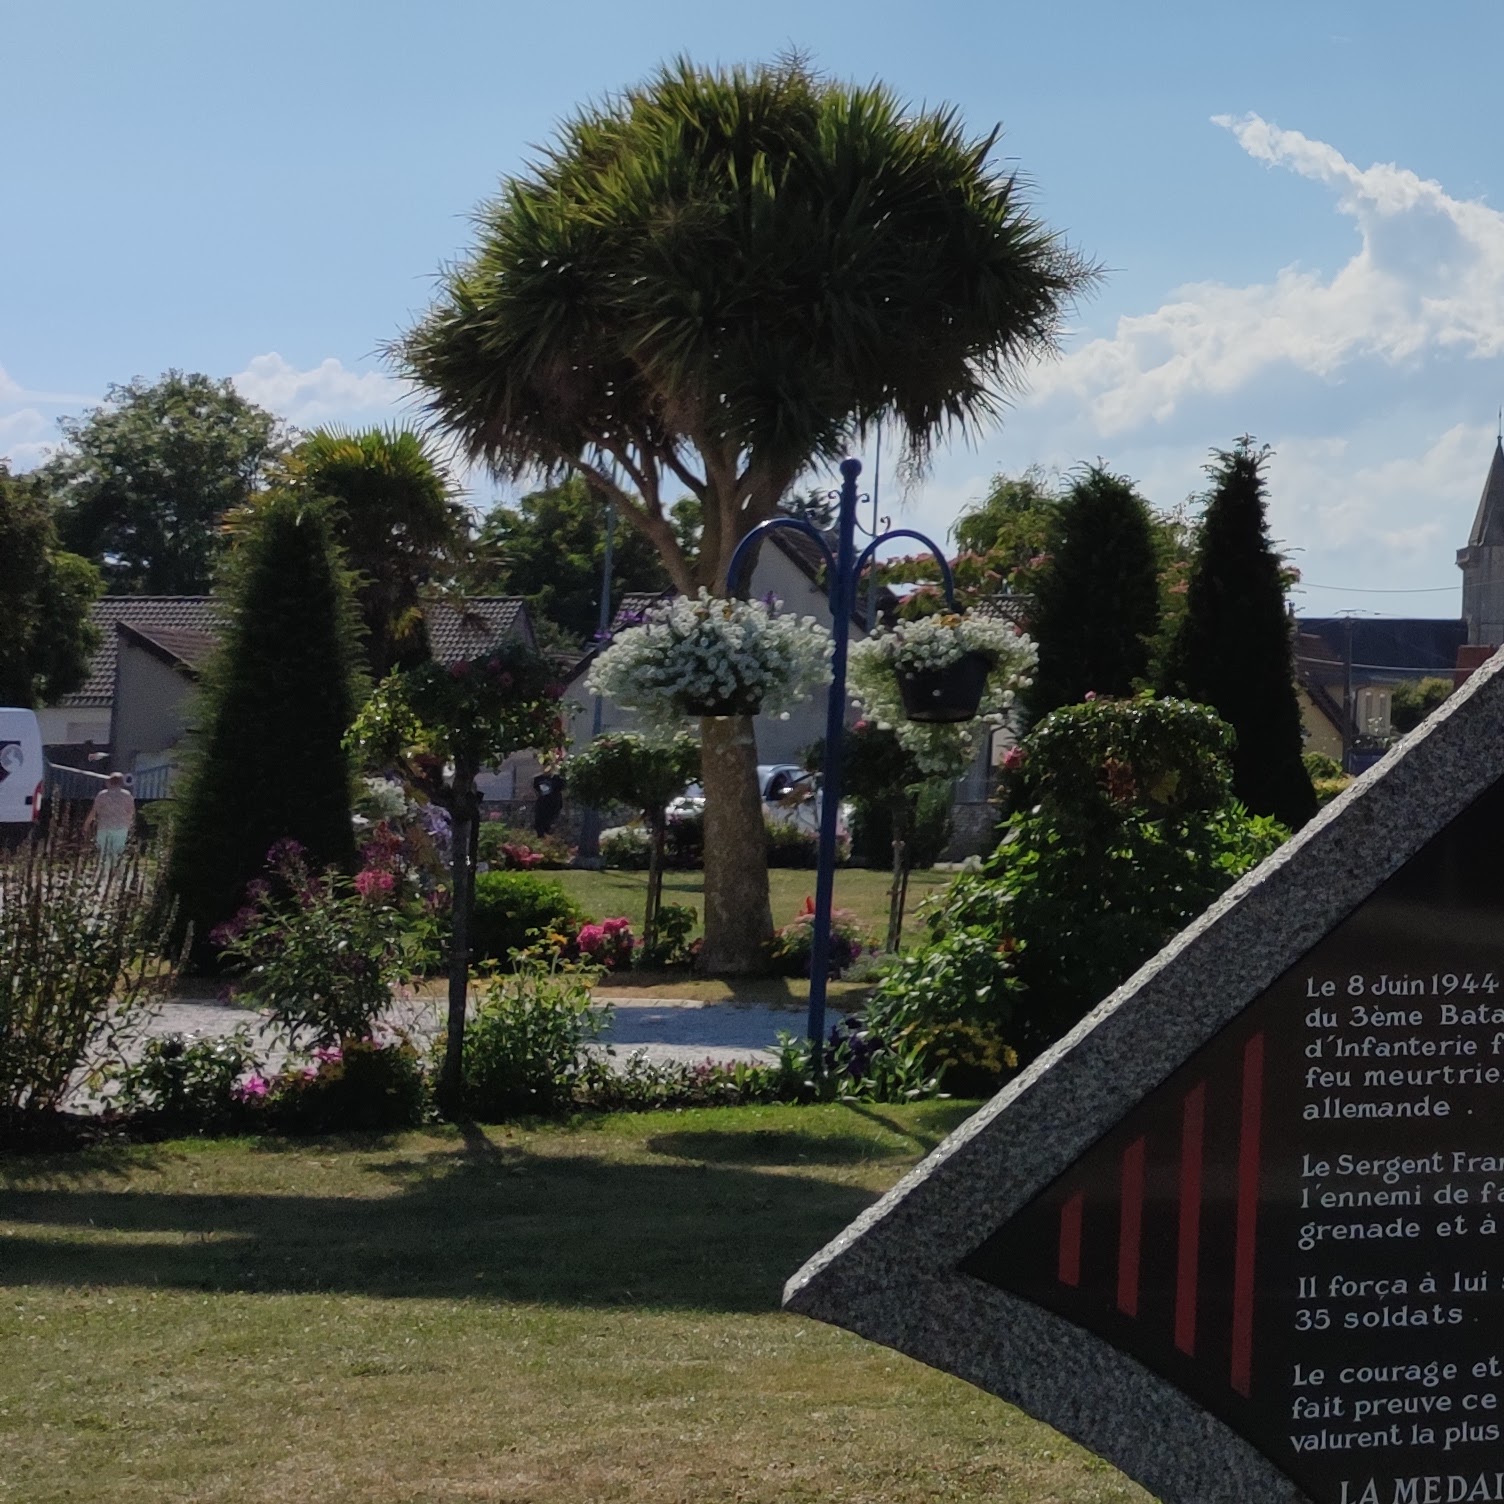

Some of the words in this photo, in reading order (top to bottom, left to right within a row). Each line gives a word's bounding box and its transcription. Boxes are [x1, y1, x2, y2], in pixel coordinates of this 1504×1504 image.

[1305, 975, 1337, 998] Le
[1346, 974, 1365, 997] 8
[1370, 973, 1425, 996] Juin
[1430, 972, 1500, 996] 1944
[1304, 1006, 1339, 1029] du
[1348, 1004, 1424, 1028] 3ème
[1304, 1065, 1352, 1089] feu
[1300, 1153, 1331, 1178] Le
[1335, 1151, 1445, 1185] Sergent
[1432, 1182, 1470, 1205] de
[1297, 1216, 1421, 1252] grenade
[1435, 1214, 1469, 1238] et
[1478, 1212, 1497, 1236] à
[1297, 1275, 1318, 1299] Il
[1327, 1274, 1409, 1302] força
[1418, 1271, 1438, 1295] à
[1451, 1269, 1488, 1293] lui
[1294, 1308, 1332, 1332] 35
[1292, 1363, 1326, 1387] Le
[1338, 1360, 1458, 1388] courage
[1471, 1355, 1503, 1379] et
[1291, 1395, 1346, 1420] fait
[1352, 1395, 1453, 1423] preuve
[1461, 1392, 1498, 1411] ce
[1289, 1423, 1404, 1454] valurent
[1409, 1422, 1436, 1446] la
[1442, 1420, 1501, 1452] plus
